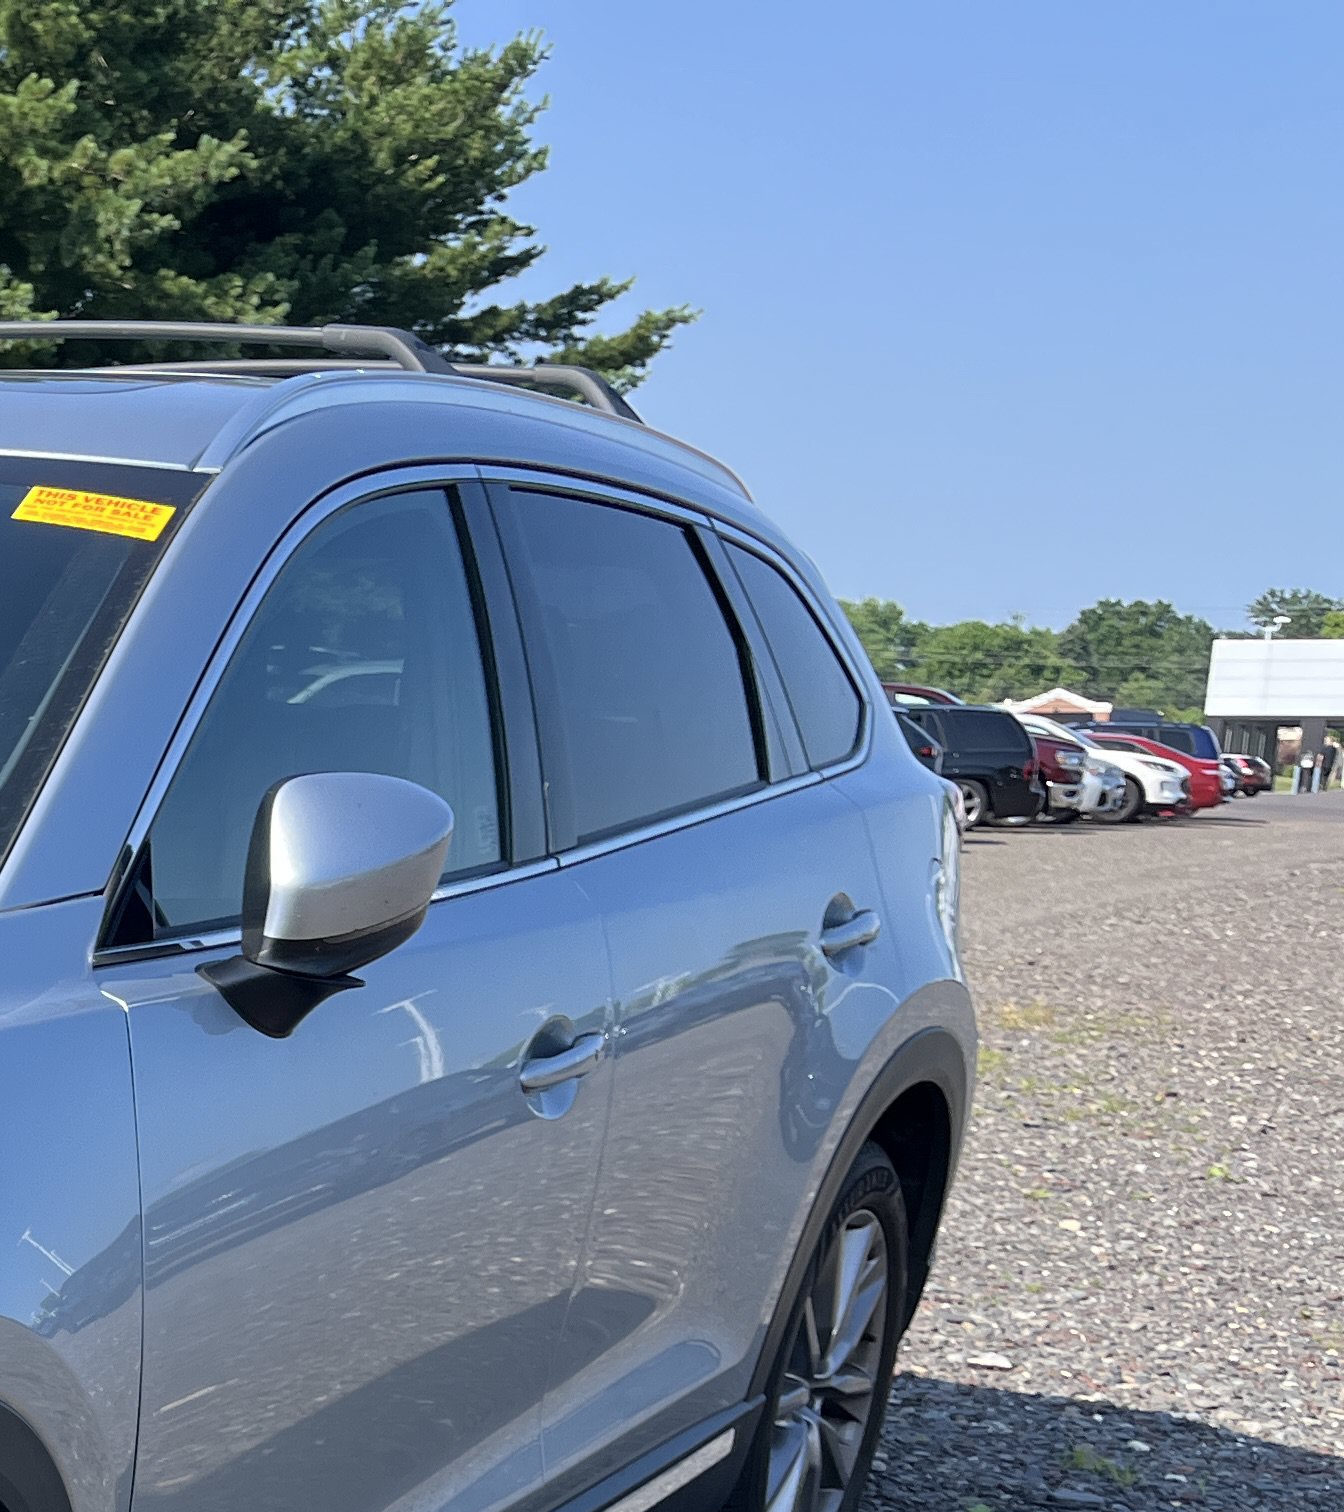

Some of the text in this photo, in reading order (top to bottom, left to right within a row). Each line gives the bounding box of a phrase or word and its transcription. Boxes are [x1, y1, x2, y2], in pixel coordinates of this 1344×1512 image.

[33, 498, 154, 521] NOT FOR SALE
[36, 489, 161, 515] THIS VEHICLE
